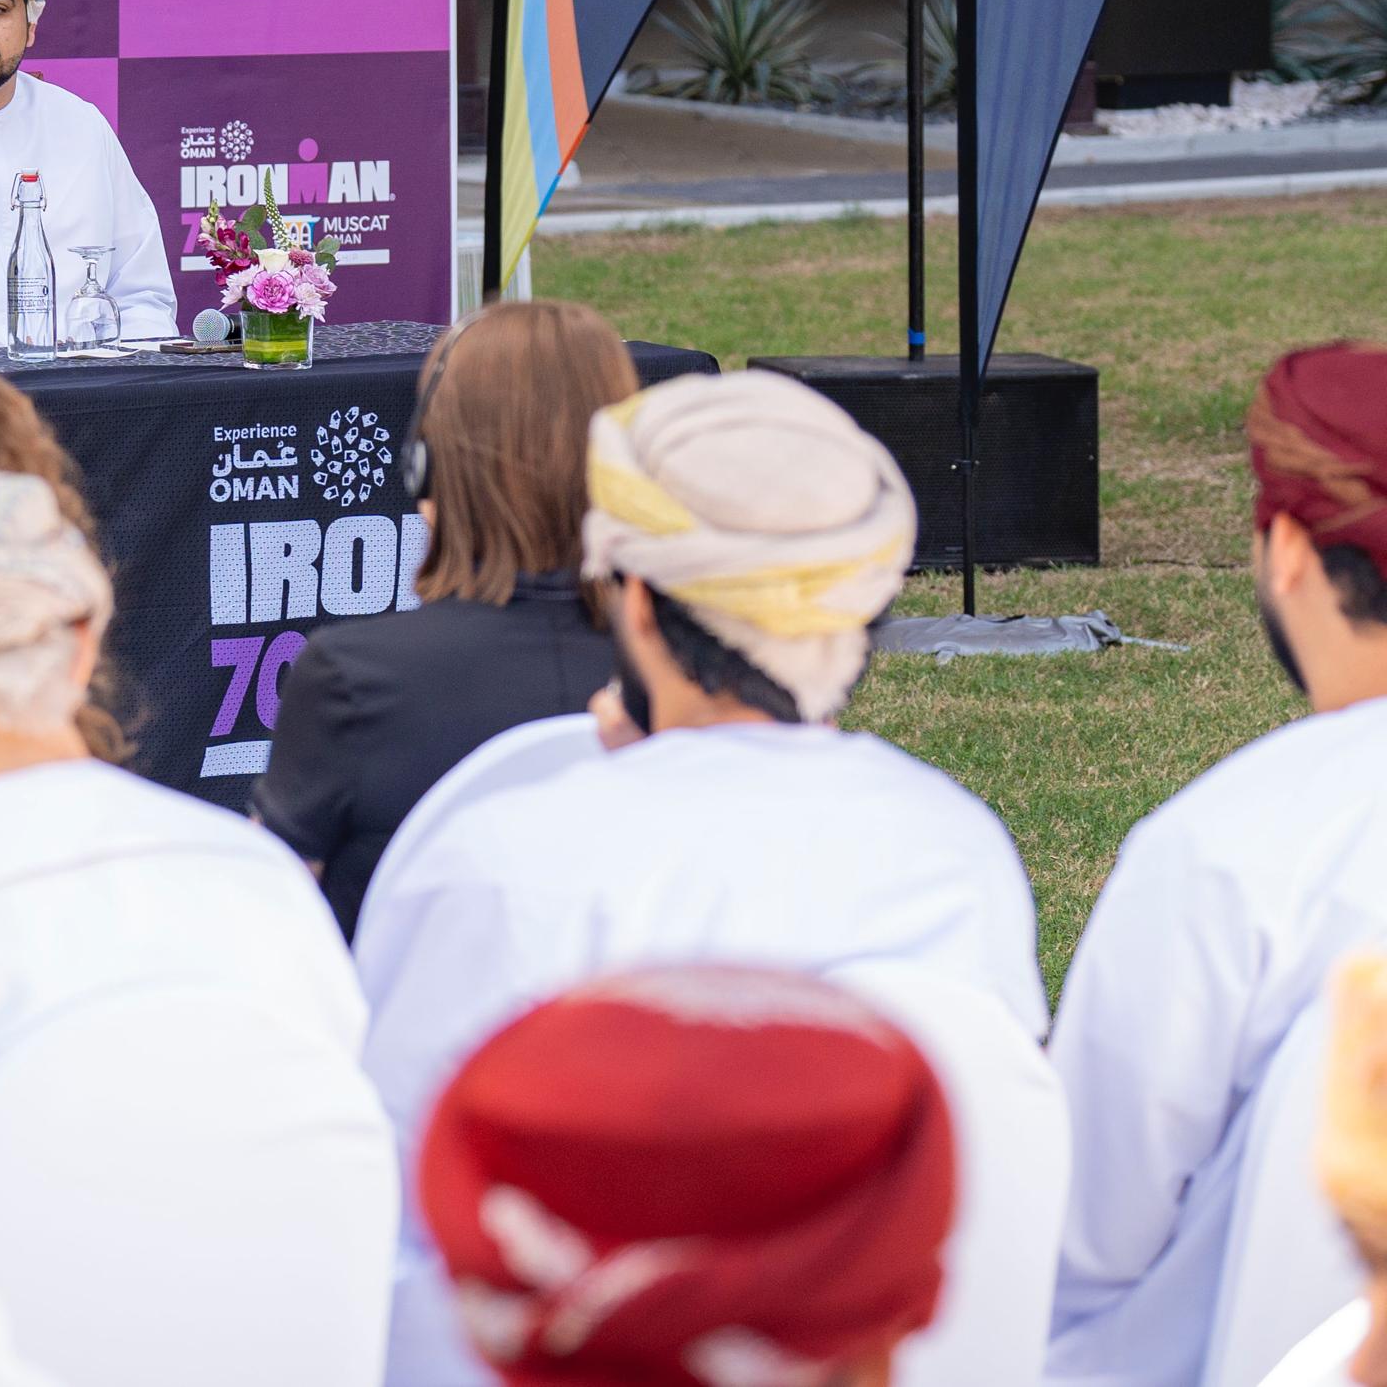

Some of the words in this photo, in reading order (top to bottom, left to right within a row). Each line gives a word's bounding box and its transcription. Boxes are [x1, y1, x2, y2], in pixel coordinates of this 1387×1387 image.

[181, 126, 215, 134] Experience
[181, 148, 215, 159] OMAN
[324, 215, 389, 232] MUSCAT
[214, 423, 297, 443] Experience
[210, 475, 299, 502] OMAN
